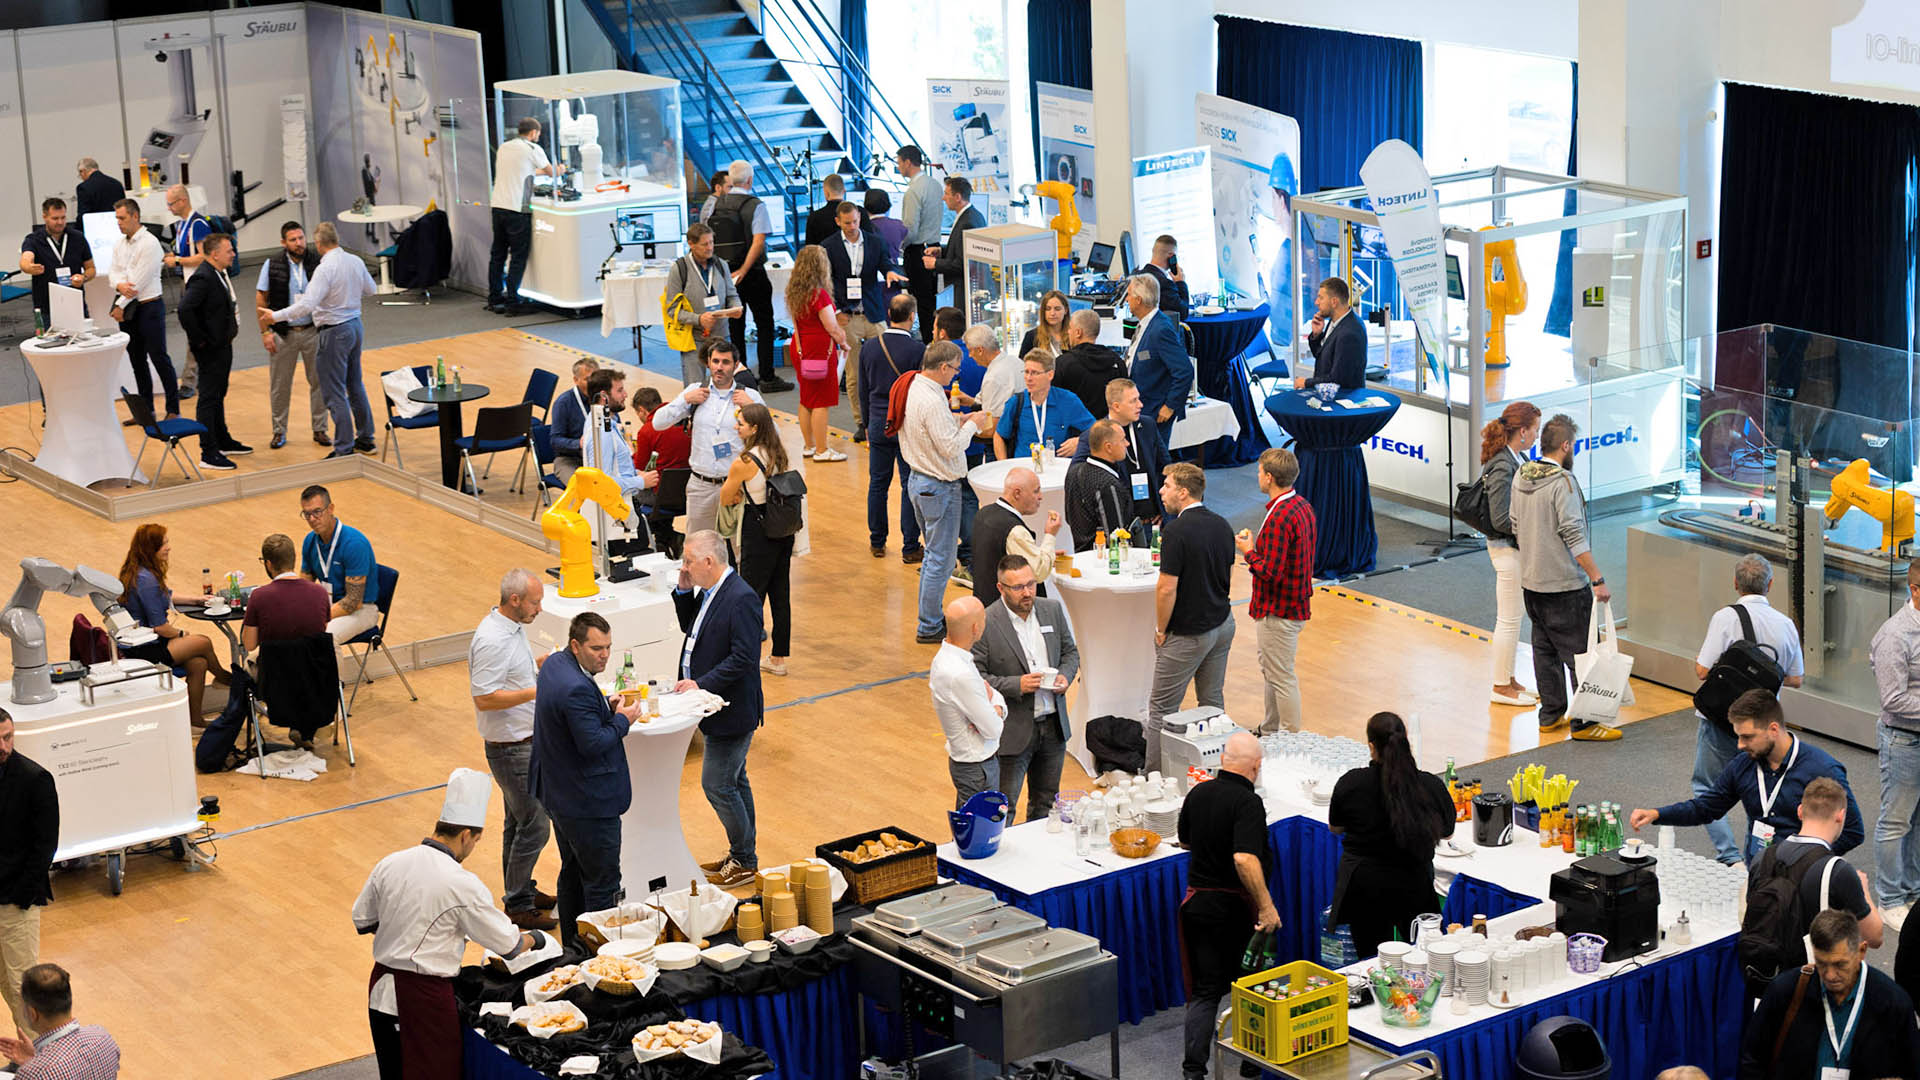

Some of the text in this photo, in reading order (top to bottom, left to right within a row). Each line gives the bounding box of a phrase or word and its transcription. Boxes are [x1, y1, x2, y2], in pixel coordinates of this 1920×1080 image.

[243, 21, 297, 38] STÄUBLI
[932, 85, 952, 94] SICK
[1073, 124, 1088, 135] SICK
[1221, 127, 1237, 143] SICK
[1145, 155, 1195, 172] LINTECH
[1579, 681, 1618, 699] STÄUBLI
